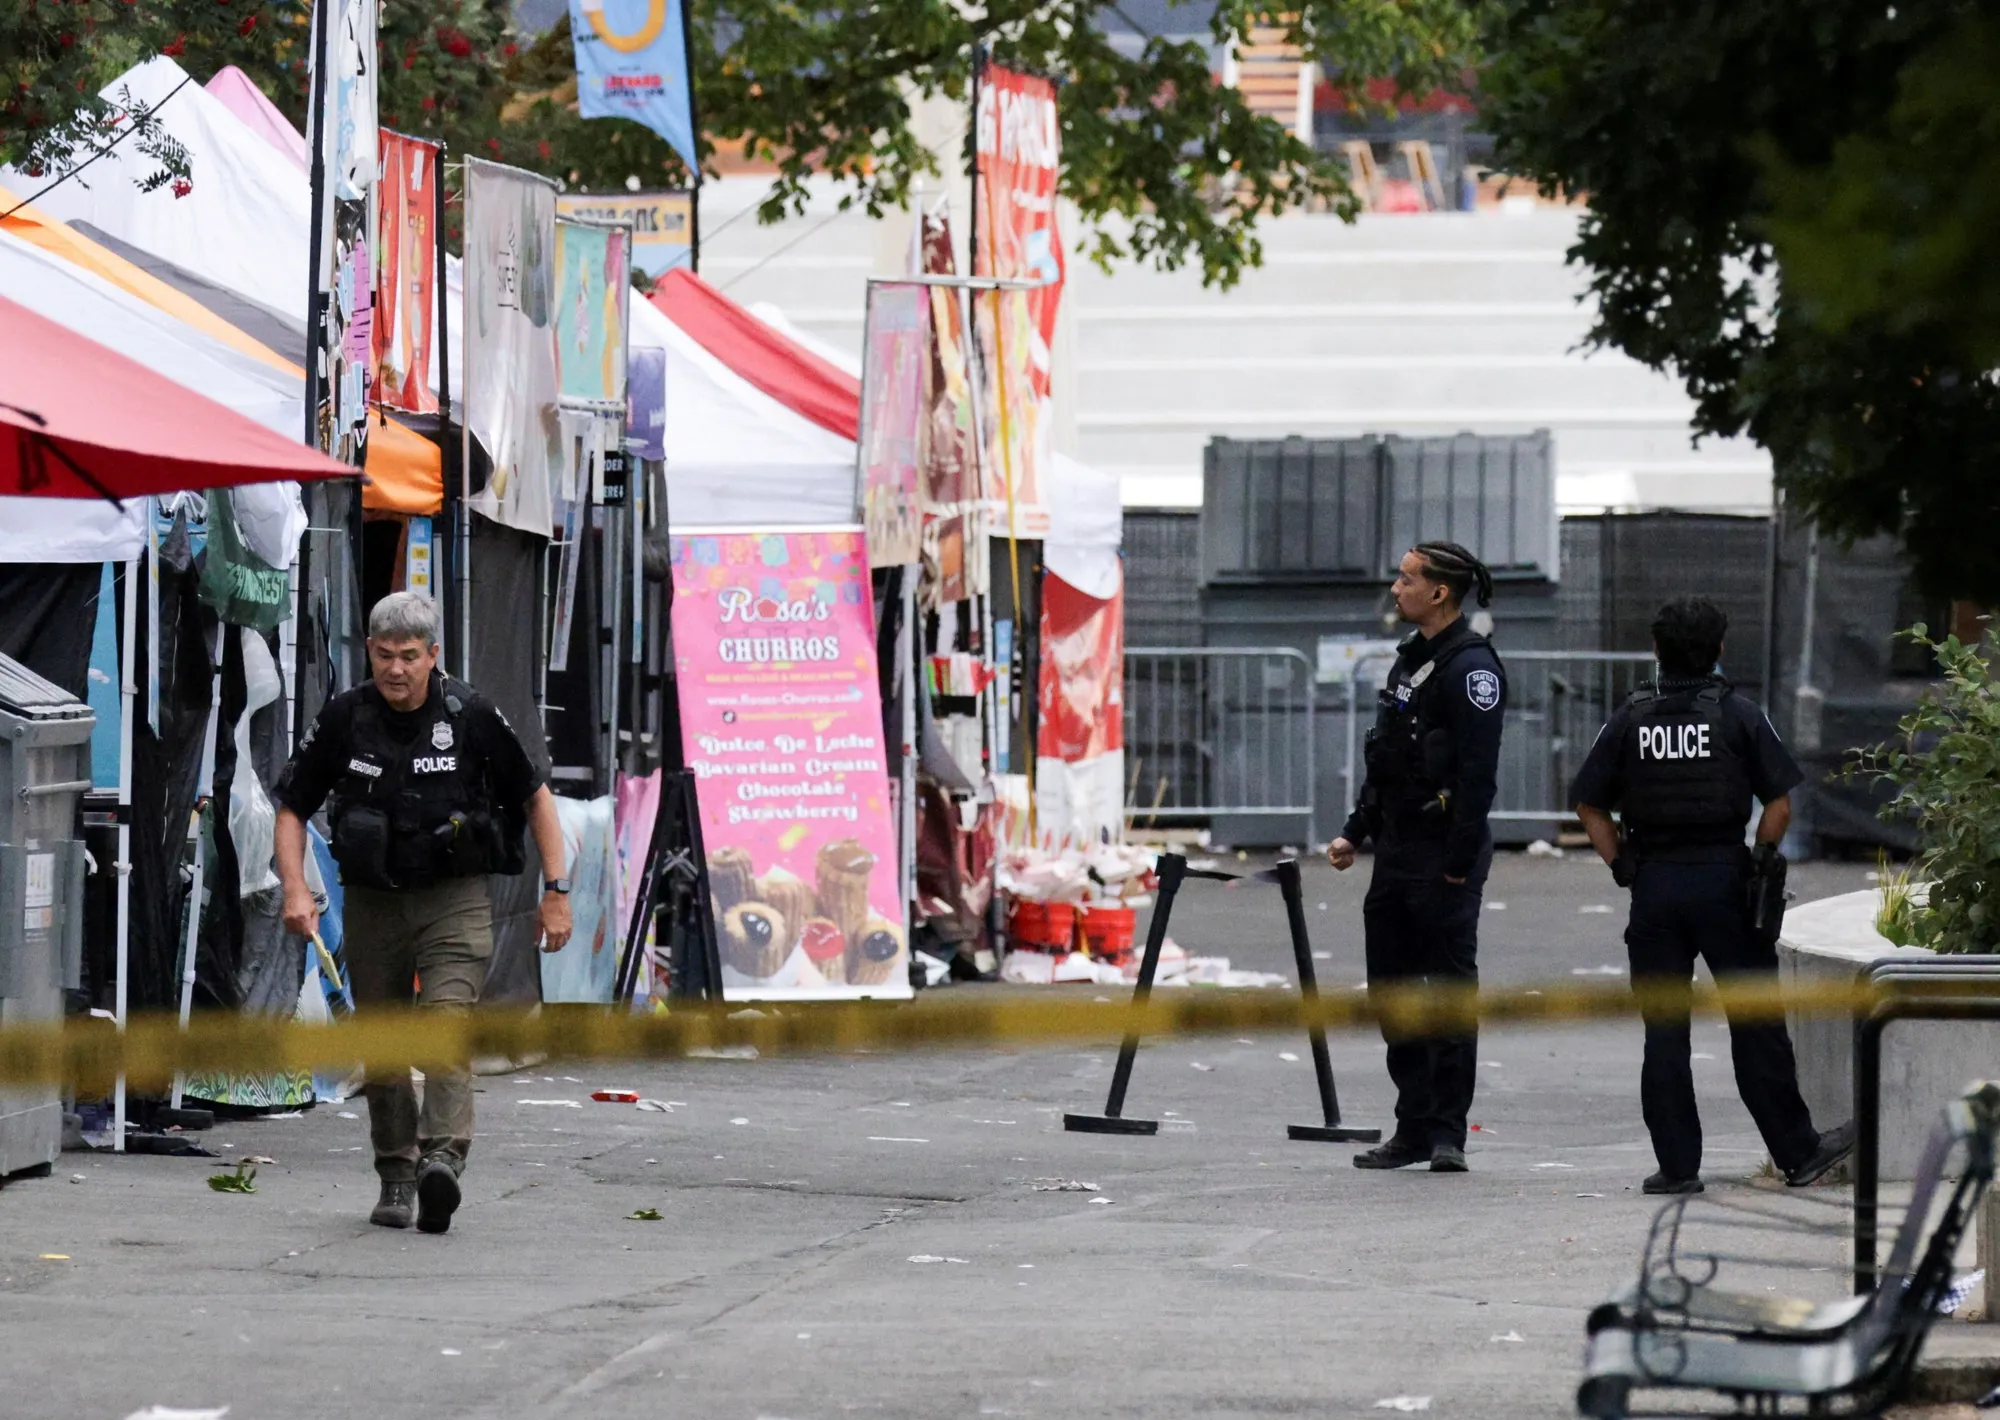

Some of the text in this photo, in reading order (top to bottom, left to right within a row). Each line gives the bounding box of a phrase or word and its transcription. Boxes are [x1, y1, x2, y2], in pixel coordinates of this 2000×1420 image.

[718, 585, 829, 622] Rosa's
[718, 635, 840, 662] CHURROS
[1472, 673, 1494, 683] SEATTLE
[1395, 684, 1413, 702] POLICE
[1476, 696, 1493, 704] POLICE
[699, 734, 875, 755] Dulce De Leche
[1638, 723, 1711, 760] POLICE
[349, 758, 383, 777] NEGOTIATOR
[413, 756, 456, 773] POLICE
[691, 758, 878, 779] Bavarian Cream
[737, 780, 845, 800] Chocolate
[728, 804, 858, 824] Strawberry
